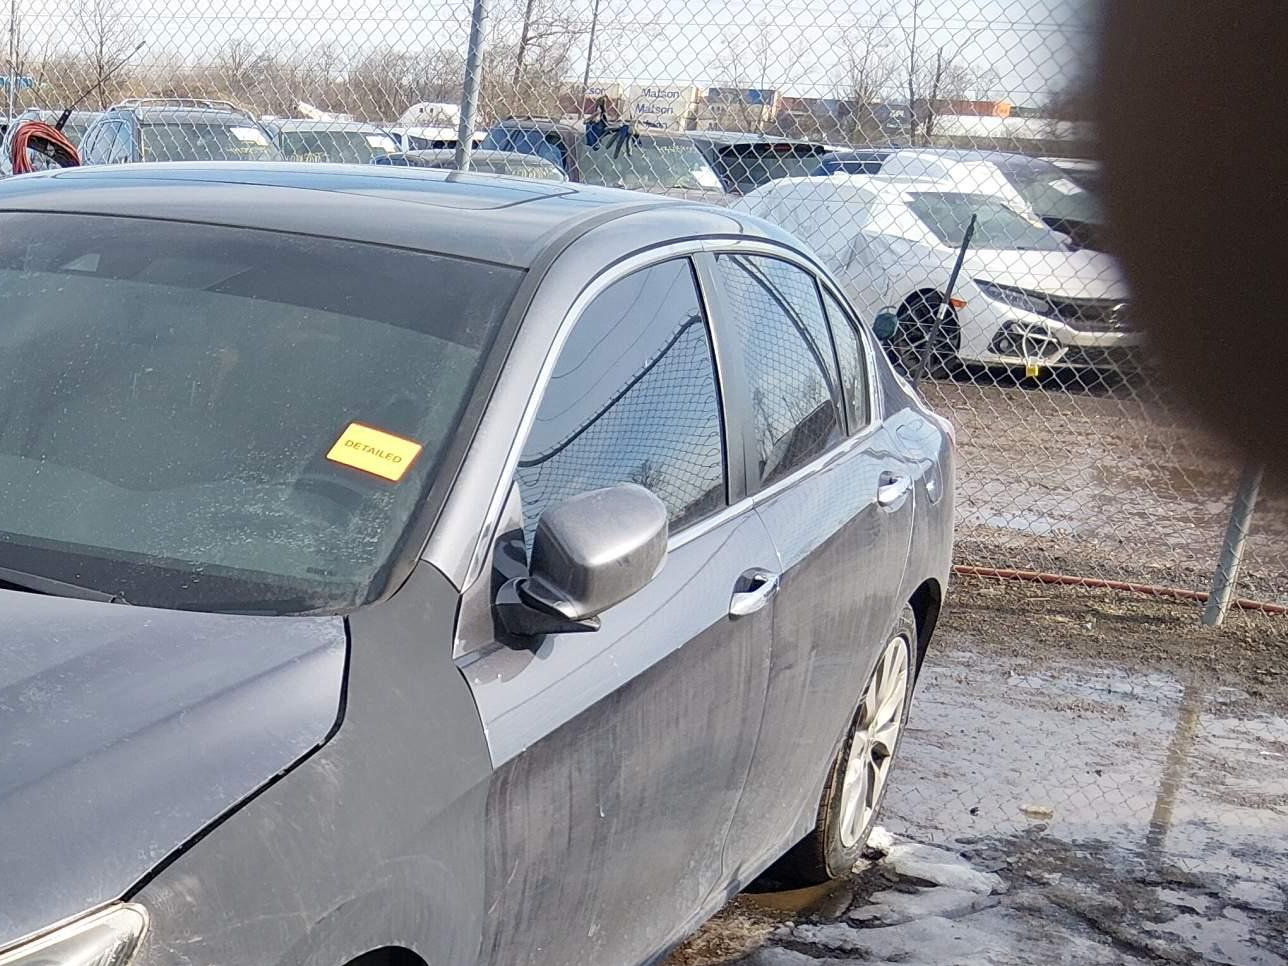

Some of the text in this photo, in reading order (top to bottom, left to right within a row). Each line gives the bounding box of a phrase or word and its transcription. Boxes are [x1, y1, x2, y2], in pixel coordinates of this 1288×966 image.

[641, 88, 680, 98] Matson
[635, 103, 674, 114] Matson
[344, 439, 402, 464] DETAILED
